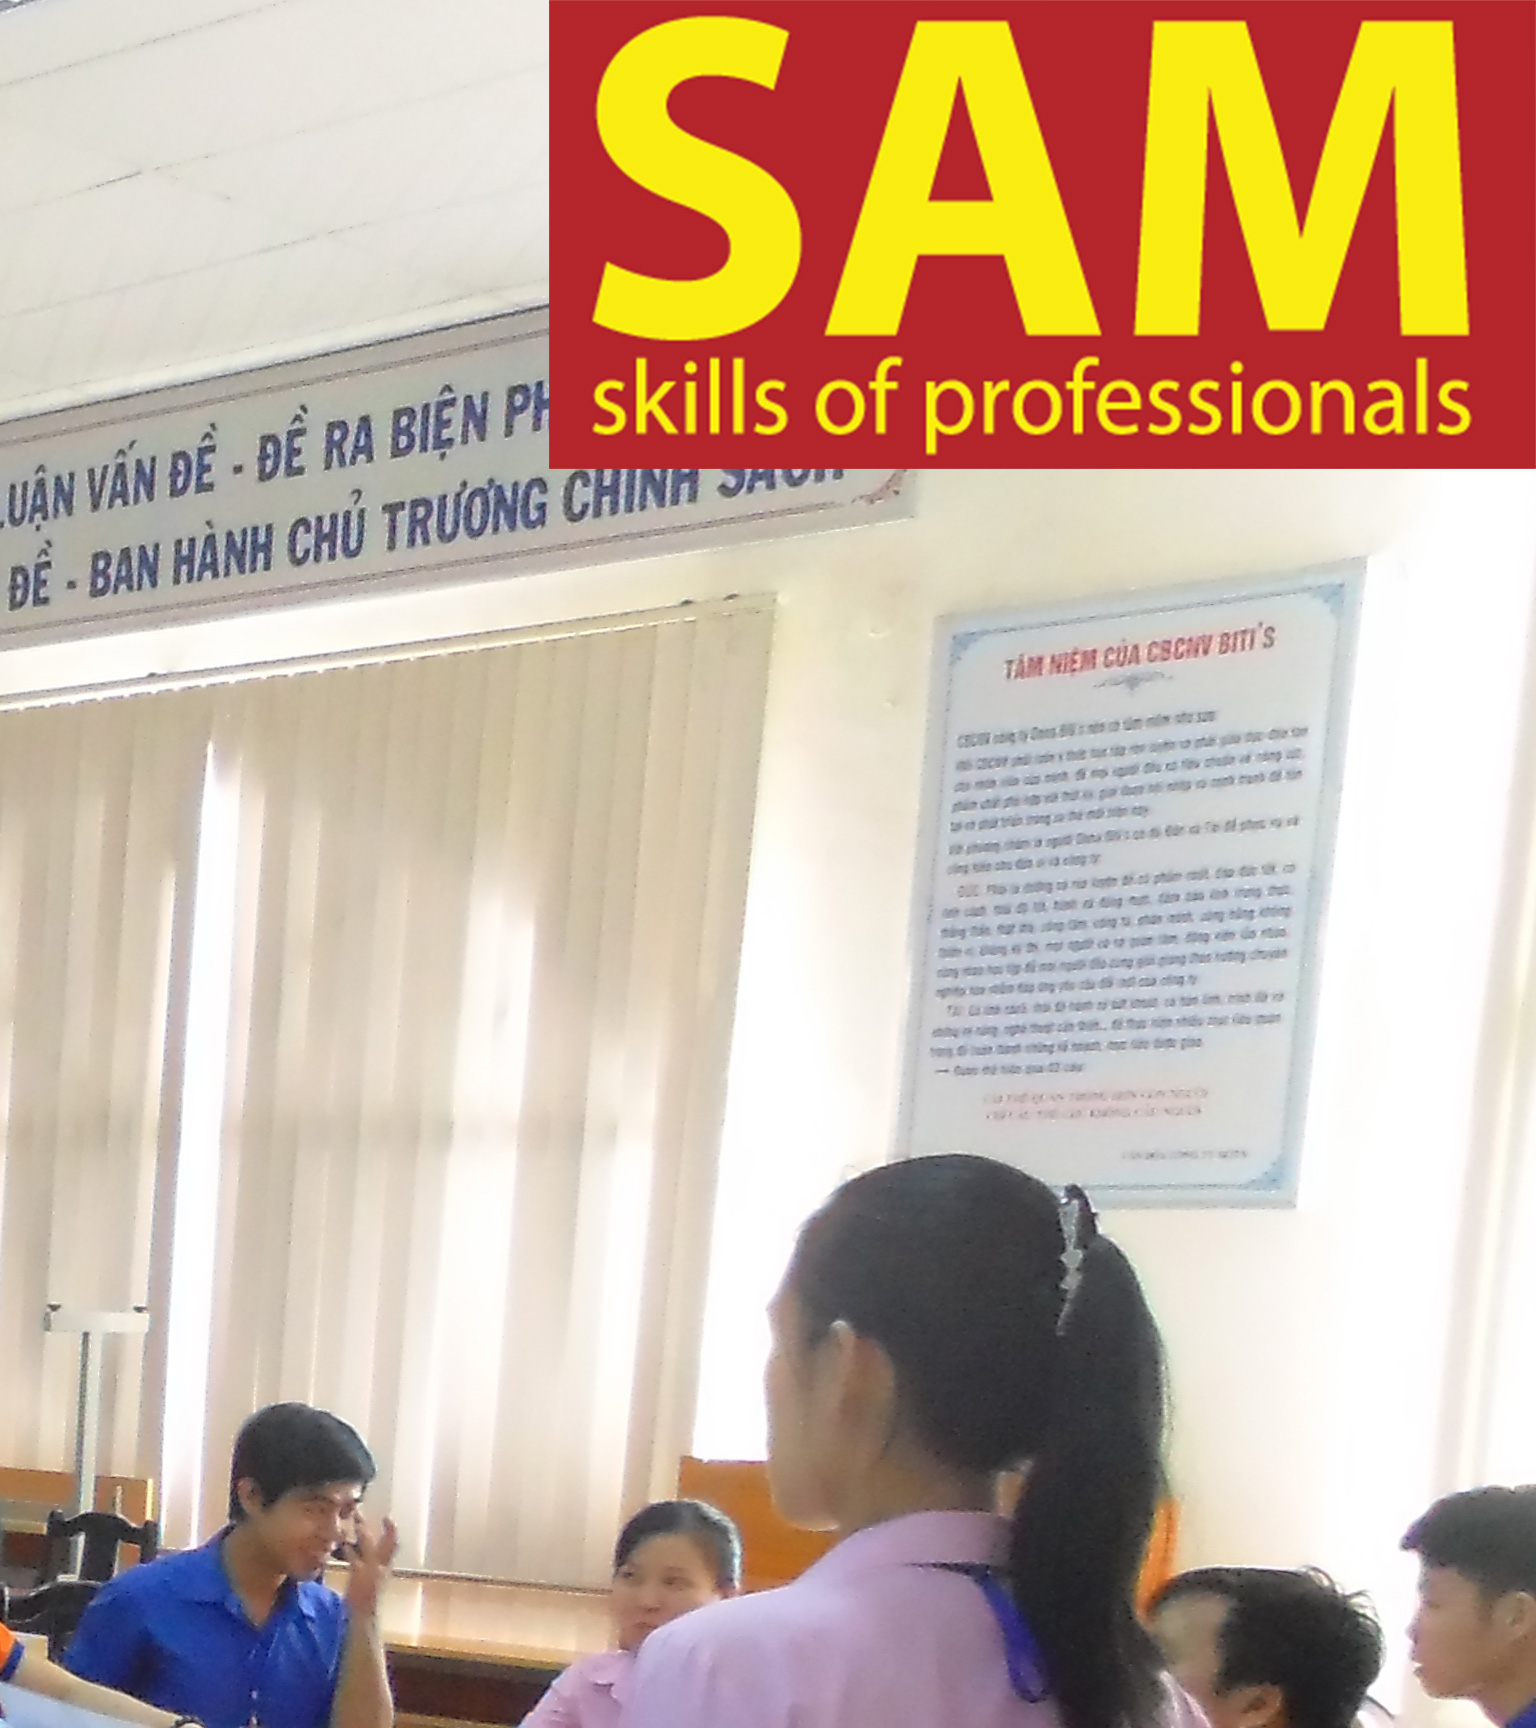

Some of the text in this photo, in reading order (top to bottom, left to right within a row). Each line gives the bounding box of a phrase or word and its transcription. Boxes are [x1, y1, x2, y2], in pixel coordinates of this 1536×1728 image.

[87, 440, 158, 513] VẤN
[168, 422, 218, 499] ĐỀ
[256, 404, 308, 483] ĐỀ
[324, 413, 376, 471] RA
[390, 382, 489, 461] BIỆN
[9, 540, 54, 611] ĐỀ
[89, 542, 161, 599] BAN
[172, 519, 274, 586] HÀNH
[287, 488, 366, 567] CHỦ
[381, 476, 549, 552] TRƯƠNG
[1103, 638, 1141, 669] CỦA
[1217, 621, 1276, 655] BITI'S
